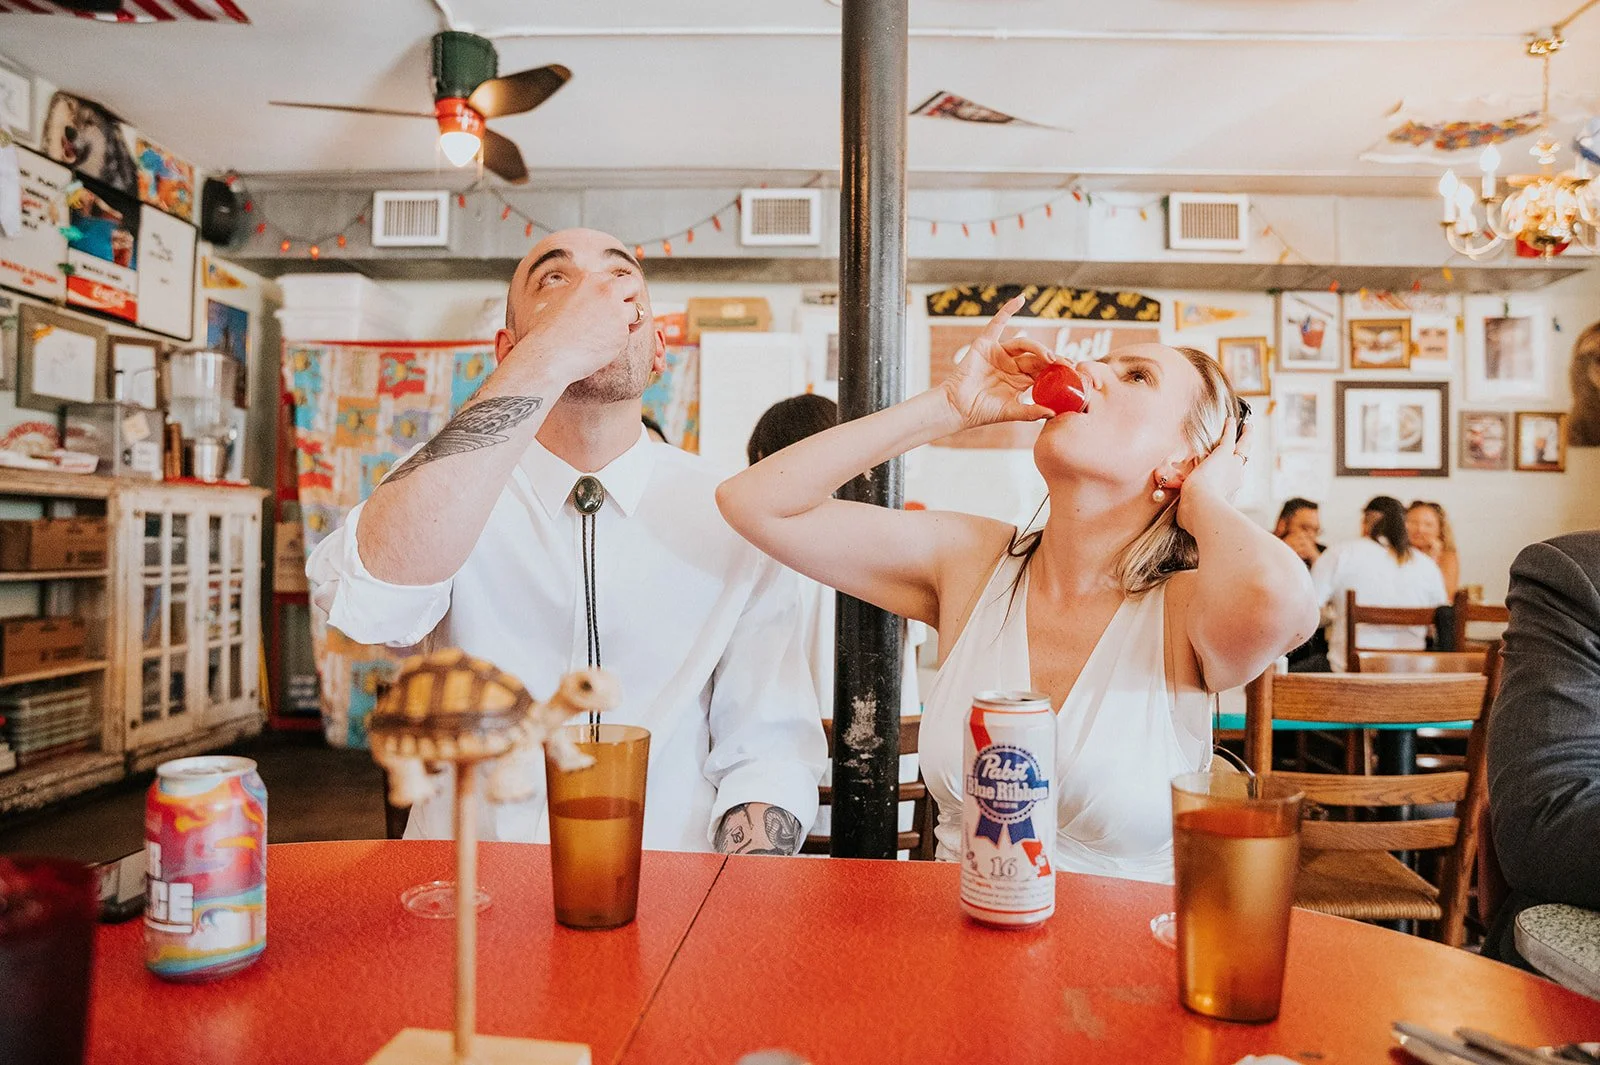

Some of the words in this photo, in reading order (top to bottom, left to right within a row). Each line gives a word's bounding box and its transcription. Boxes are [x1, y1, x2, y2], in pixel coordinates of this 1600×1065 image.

[980, 753, 1030, 781] Pabst
[967, 776, 996, 800] Blue
[995, 781, 1048, 801] Ribbon
[990, 856, 1017, 877] 16
